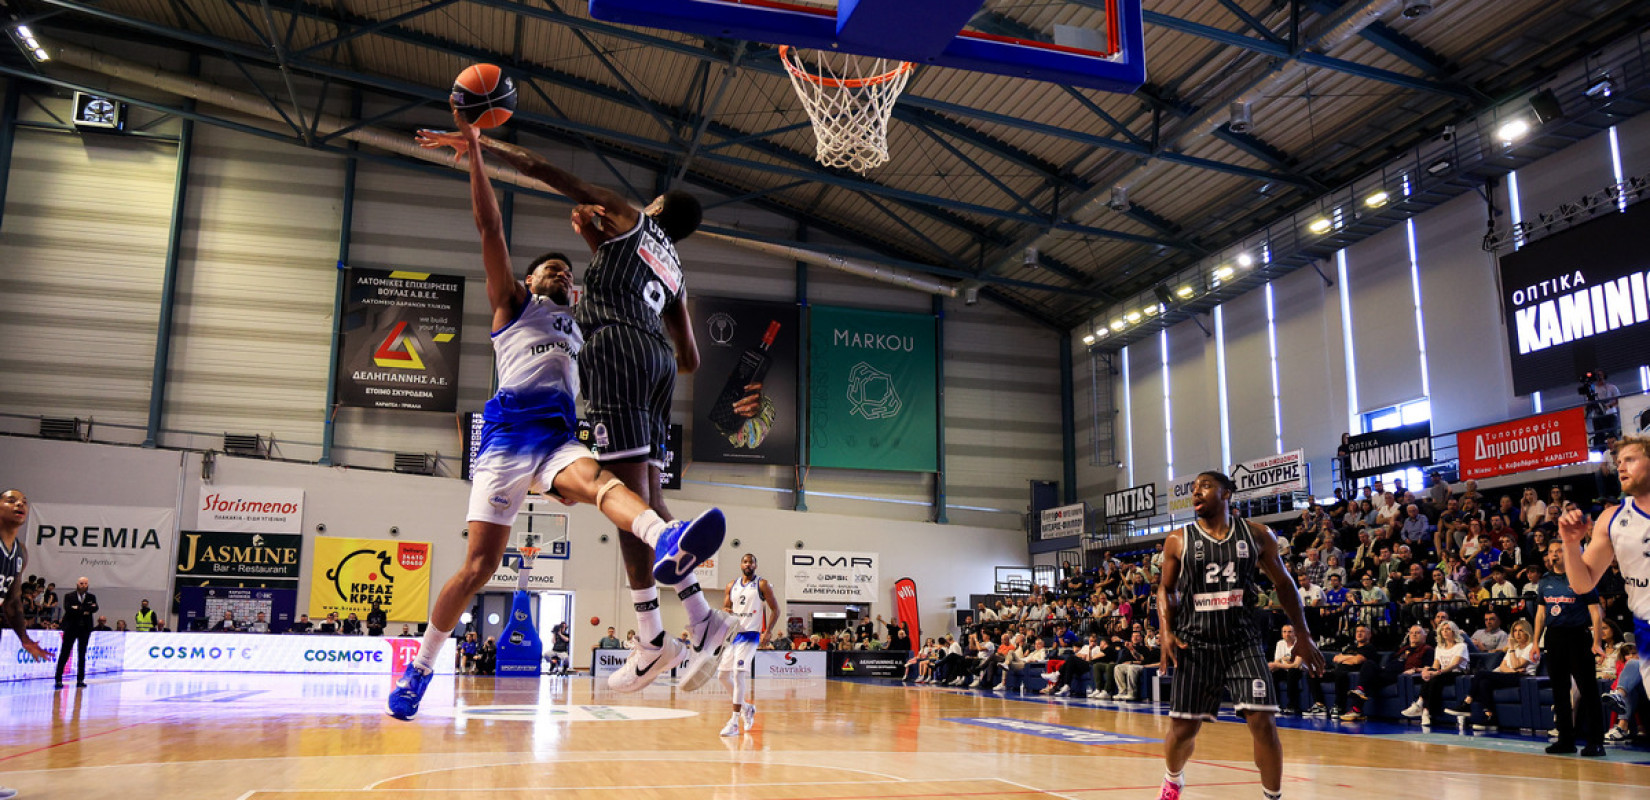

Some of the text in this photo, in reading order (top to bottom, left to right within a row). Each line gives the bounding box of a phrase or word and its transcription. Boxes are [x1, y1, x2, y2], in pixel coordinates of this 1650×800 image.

[1513, 270, 1585, 305] ΟΠΤΙΚΑ
[1515, 271, 1650, 355] ΚΑΜΙΝΙ
[834, 328, 914, 352] MARKOU
[353, 370, 428, 384] ΔΕΛΗΓΙΑΝΝΗΣ
[392, 388, 433, 398] ΣΚΥΡΟΔΕΜΑ
[1350, 437, 1430, 472] ΚΑΜΙΝΙΩΤΗ
[1475, 430, 1560, 460] Δημιουργία
[1241, 464, 1300, 488] ΓΚΙΟΥΡΗΣ
[202, 494, 298, 514] Storismenos
[1106, 485, 1153, 517] MATTAS
[36, 524, 161, 549] PREMIA
[178, 534, 297, 571] JASMINE
[792, 555, 873, 568] DMR
[213, 563, 230, 572] Bar
[238, 564, 287, 574] Restaurant
[1206, 562, 1236, 583] 24
[351, 583, 393, 595] ΚΡΕΑΣ
[740, 595, 746, 605] 2
[770, 664, 812, 673] Stavrakis
